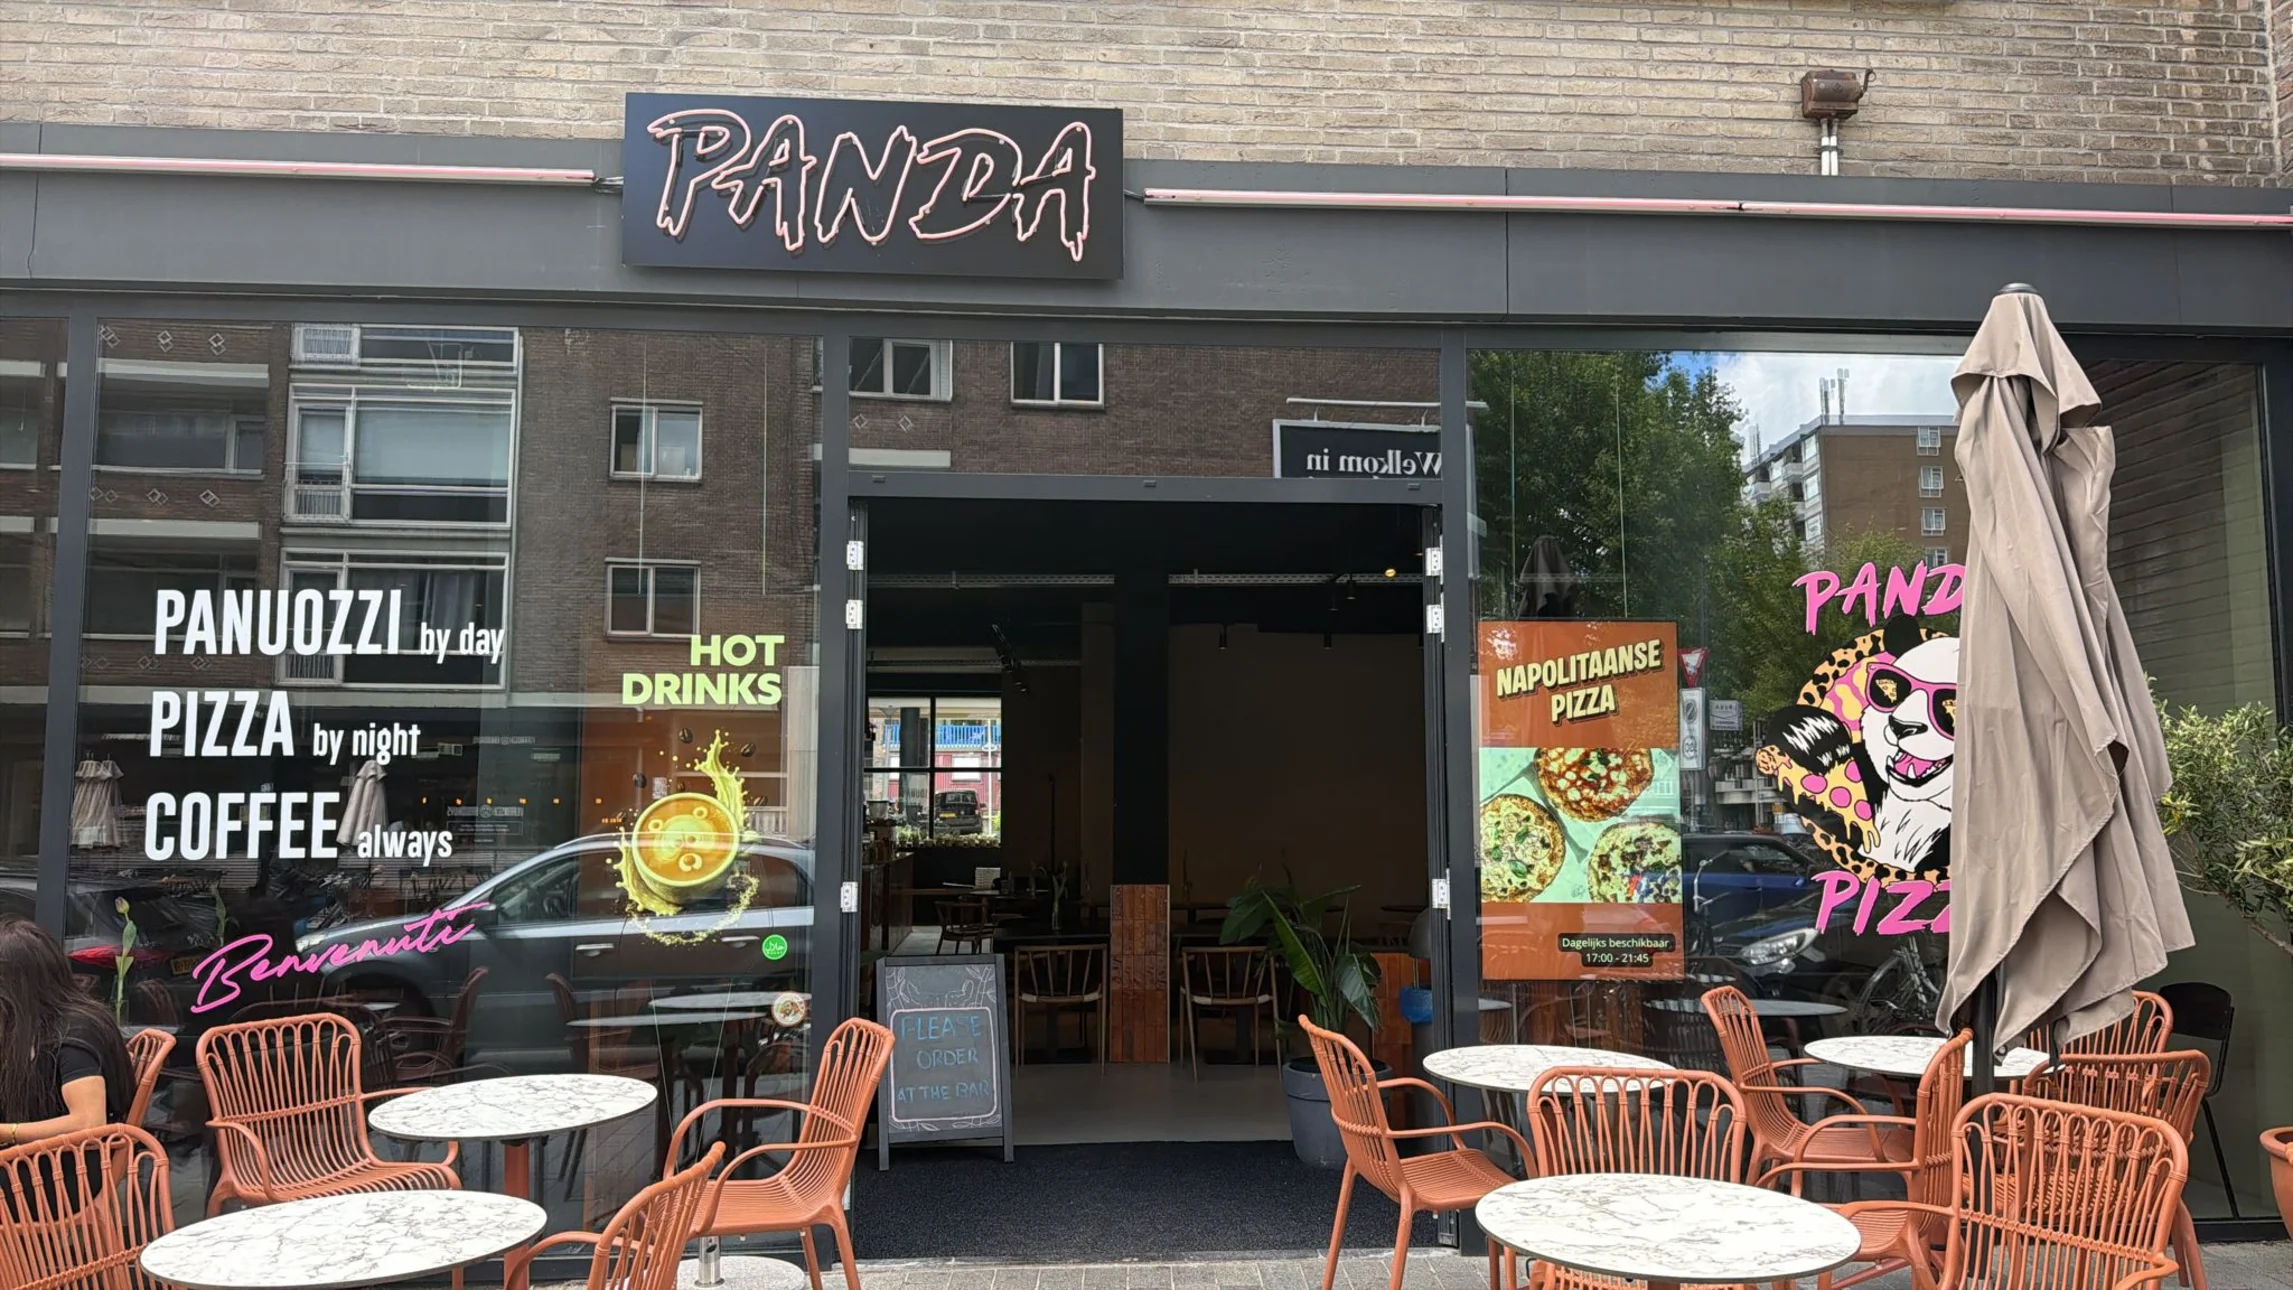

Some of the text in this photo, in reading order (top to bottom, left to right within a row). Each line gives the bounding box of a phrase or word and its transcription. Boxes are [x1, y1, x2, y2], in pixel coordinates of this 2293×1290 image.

[647, 108, 1097, 262] PANDA
[154, 588, 505, 664] PANUOZZI by day
[1792, 560, 1966, 636] PAND
[690, 634, 785, 667] HOT
[1496, 639, 1662, 698] NAPOLITAANSE
[622, 673, 782, 705] DRINKS
[1551, 684, 1616, 723] PIZZA
[150, 690, 421, 766] PIZZA by night
[144, 792, 453, 867] COFFEE always
[1811, 869, 1950, 936] PIZ
[190, 902, 490, 1014] Benvenuti
[1562, 938, 1669, 951] Dagelijks beschikbaar
[1586, 953, 1613, 963] 17:00
[1621, 953, 1649, 963] 21:45
[916, 1047, 979, 1070] ORDER
[896, 1080, 990, 1103] AT THE BAR
